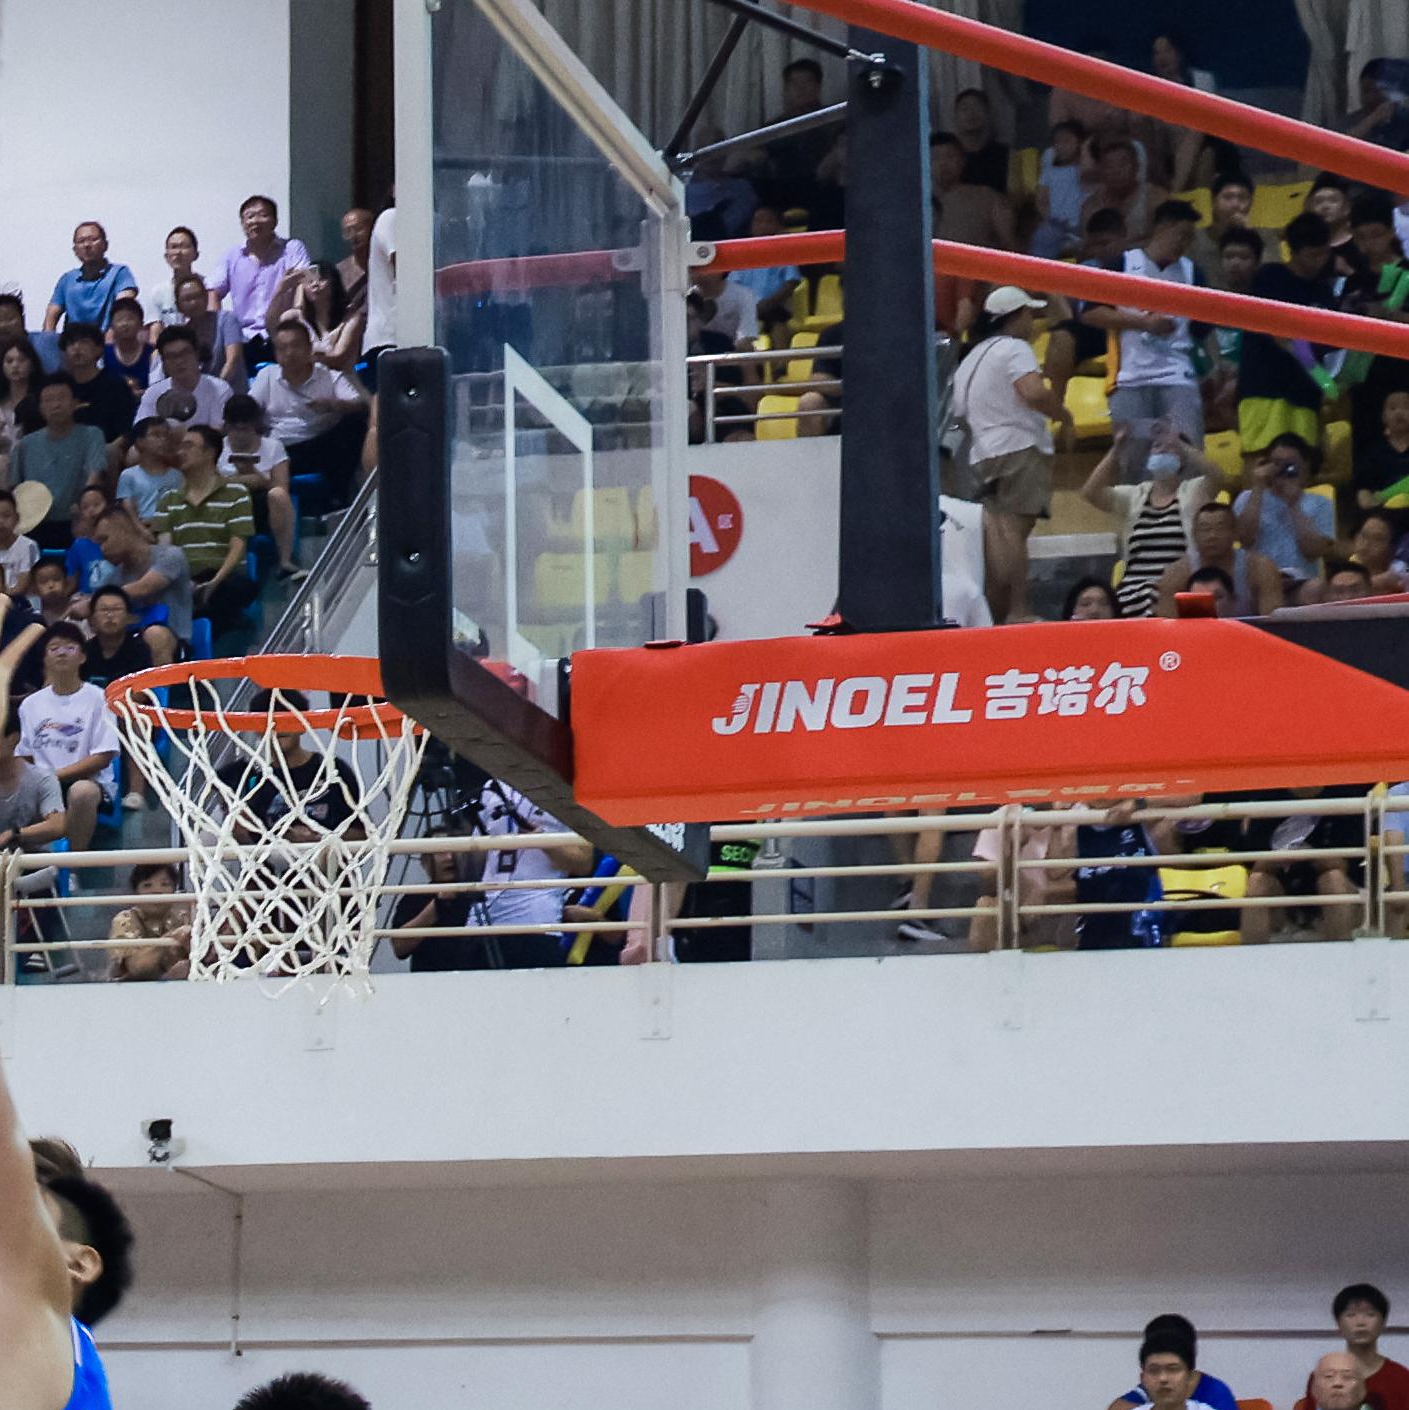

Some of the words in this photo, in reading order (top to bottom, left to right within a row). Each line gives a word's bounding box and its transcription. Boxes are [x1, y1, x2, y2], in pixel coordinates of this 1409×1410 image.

[711, 671, 974, 736] JINOEL
[984, 661, 1150, 721] 吉诺尔
